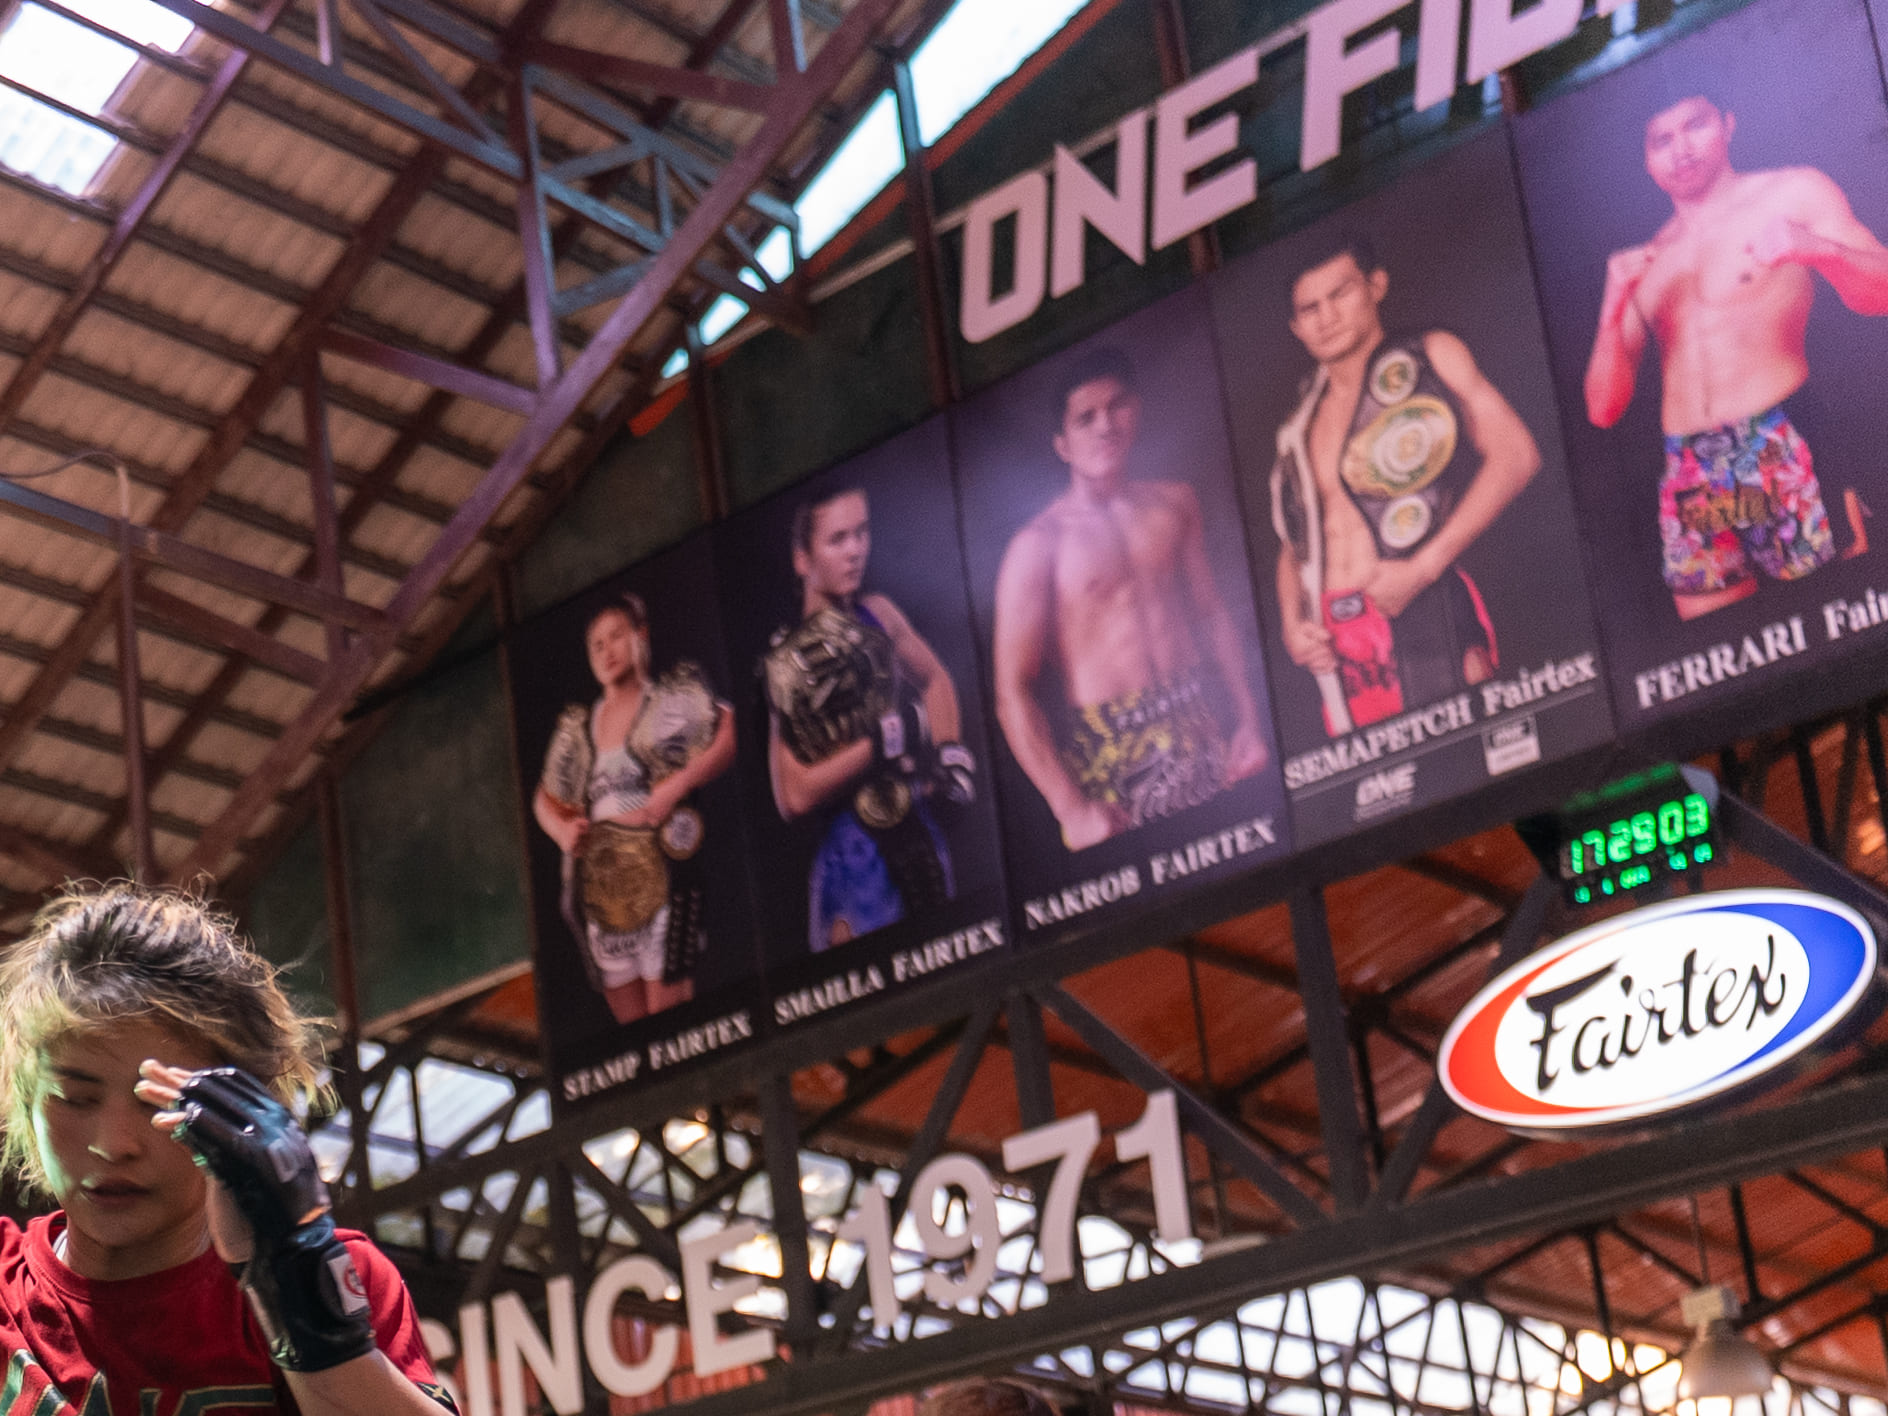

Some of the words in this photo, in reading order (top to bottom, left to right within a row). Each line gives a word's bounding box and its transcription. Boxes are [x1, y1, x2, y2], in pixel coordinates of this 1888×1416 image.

[960, 48, 1259, 344] ONE
[1283, 692, 1474, 790] SEMAPETCH
[1480, 651, 1597, 717] Fairtex
[1635, 615, 1807, 709] FERRARI
[1024, 864, 1141, 930] NAKROB
[1149, 816, 1276, 884] FAIRTEX
[774, 963, 885, 1026] SMAILLA
[892, 918, 1004, 983] FAIRTEX
[1524, 934, 1786, 1096] Fairtex
[563, 1051, 641, 1101] STAMP
[648, 1010, 752, 1070] FAIRTEX
[834, 1089, 1192, 1327] 1971
